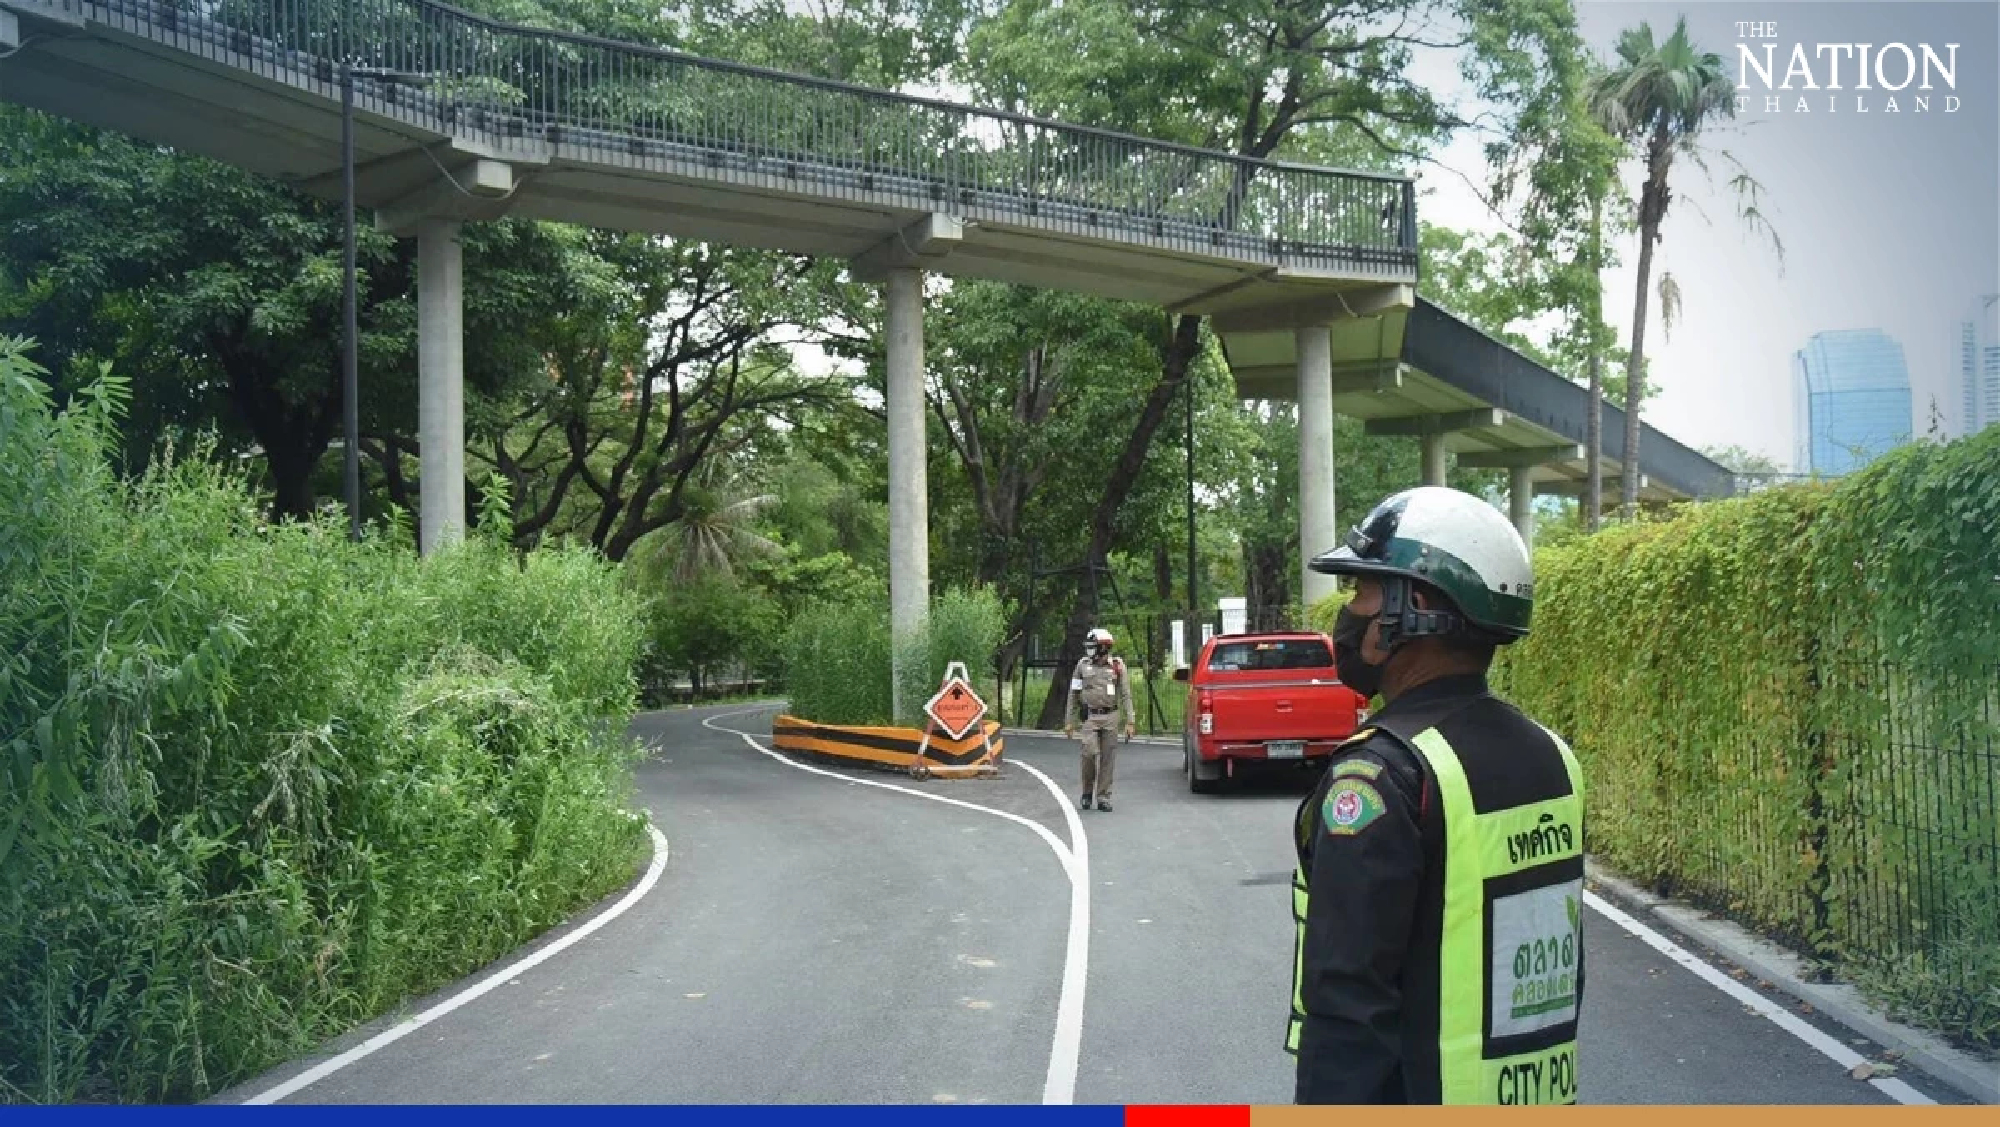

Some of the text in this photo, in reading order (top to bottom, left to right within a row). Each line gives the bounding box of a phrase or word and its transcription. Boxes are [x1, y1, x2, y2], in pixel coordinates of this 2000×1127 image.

[1507, 813, 1572, 864] เทศกิจ
[1513, 932, 1574, 979] ตลาด
[1498, 1060, 1543, 1105] CITY
